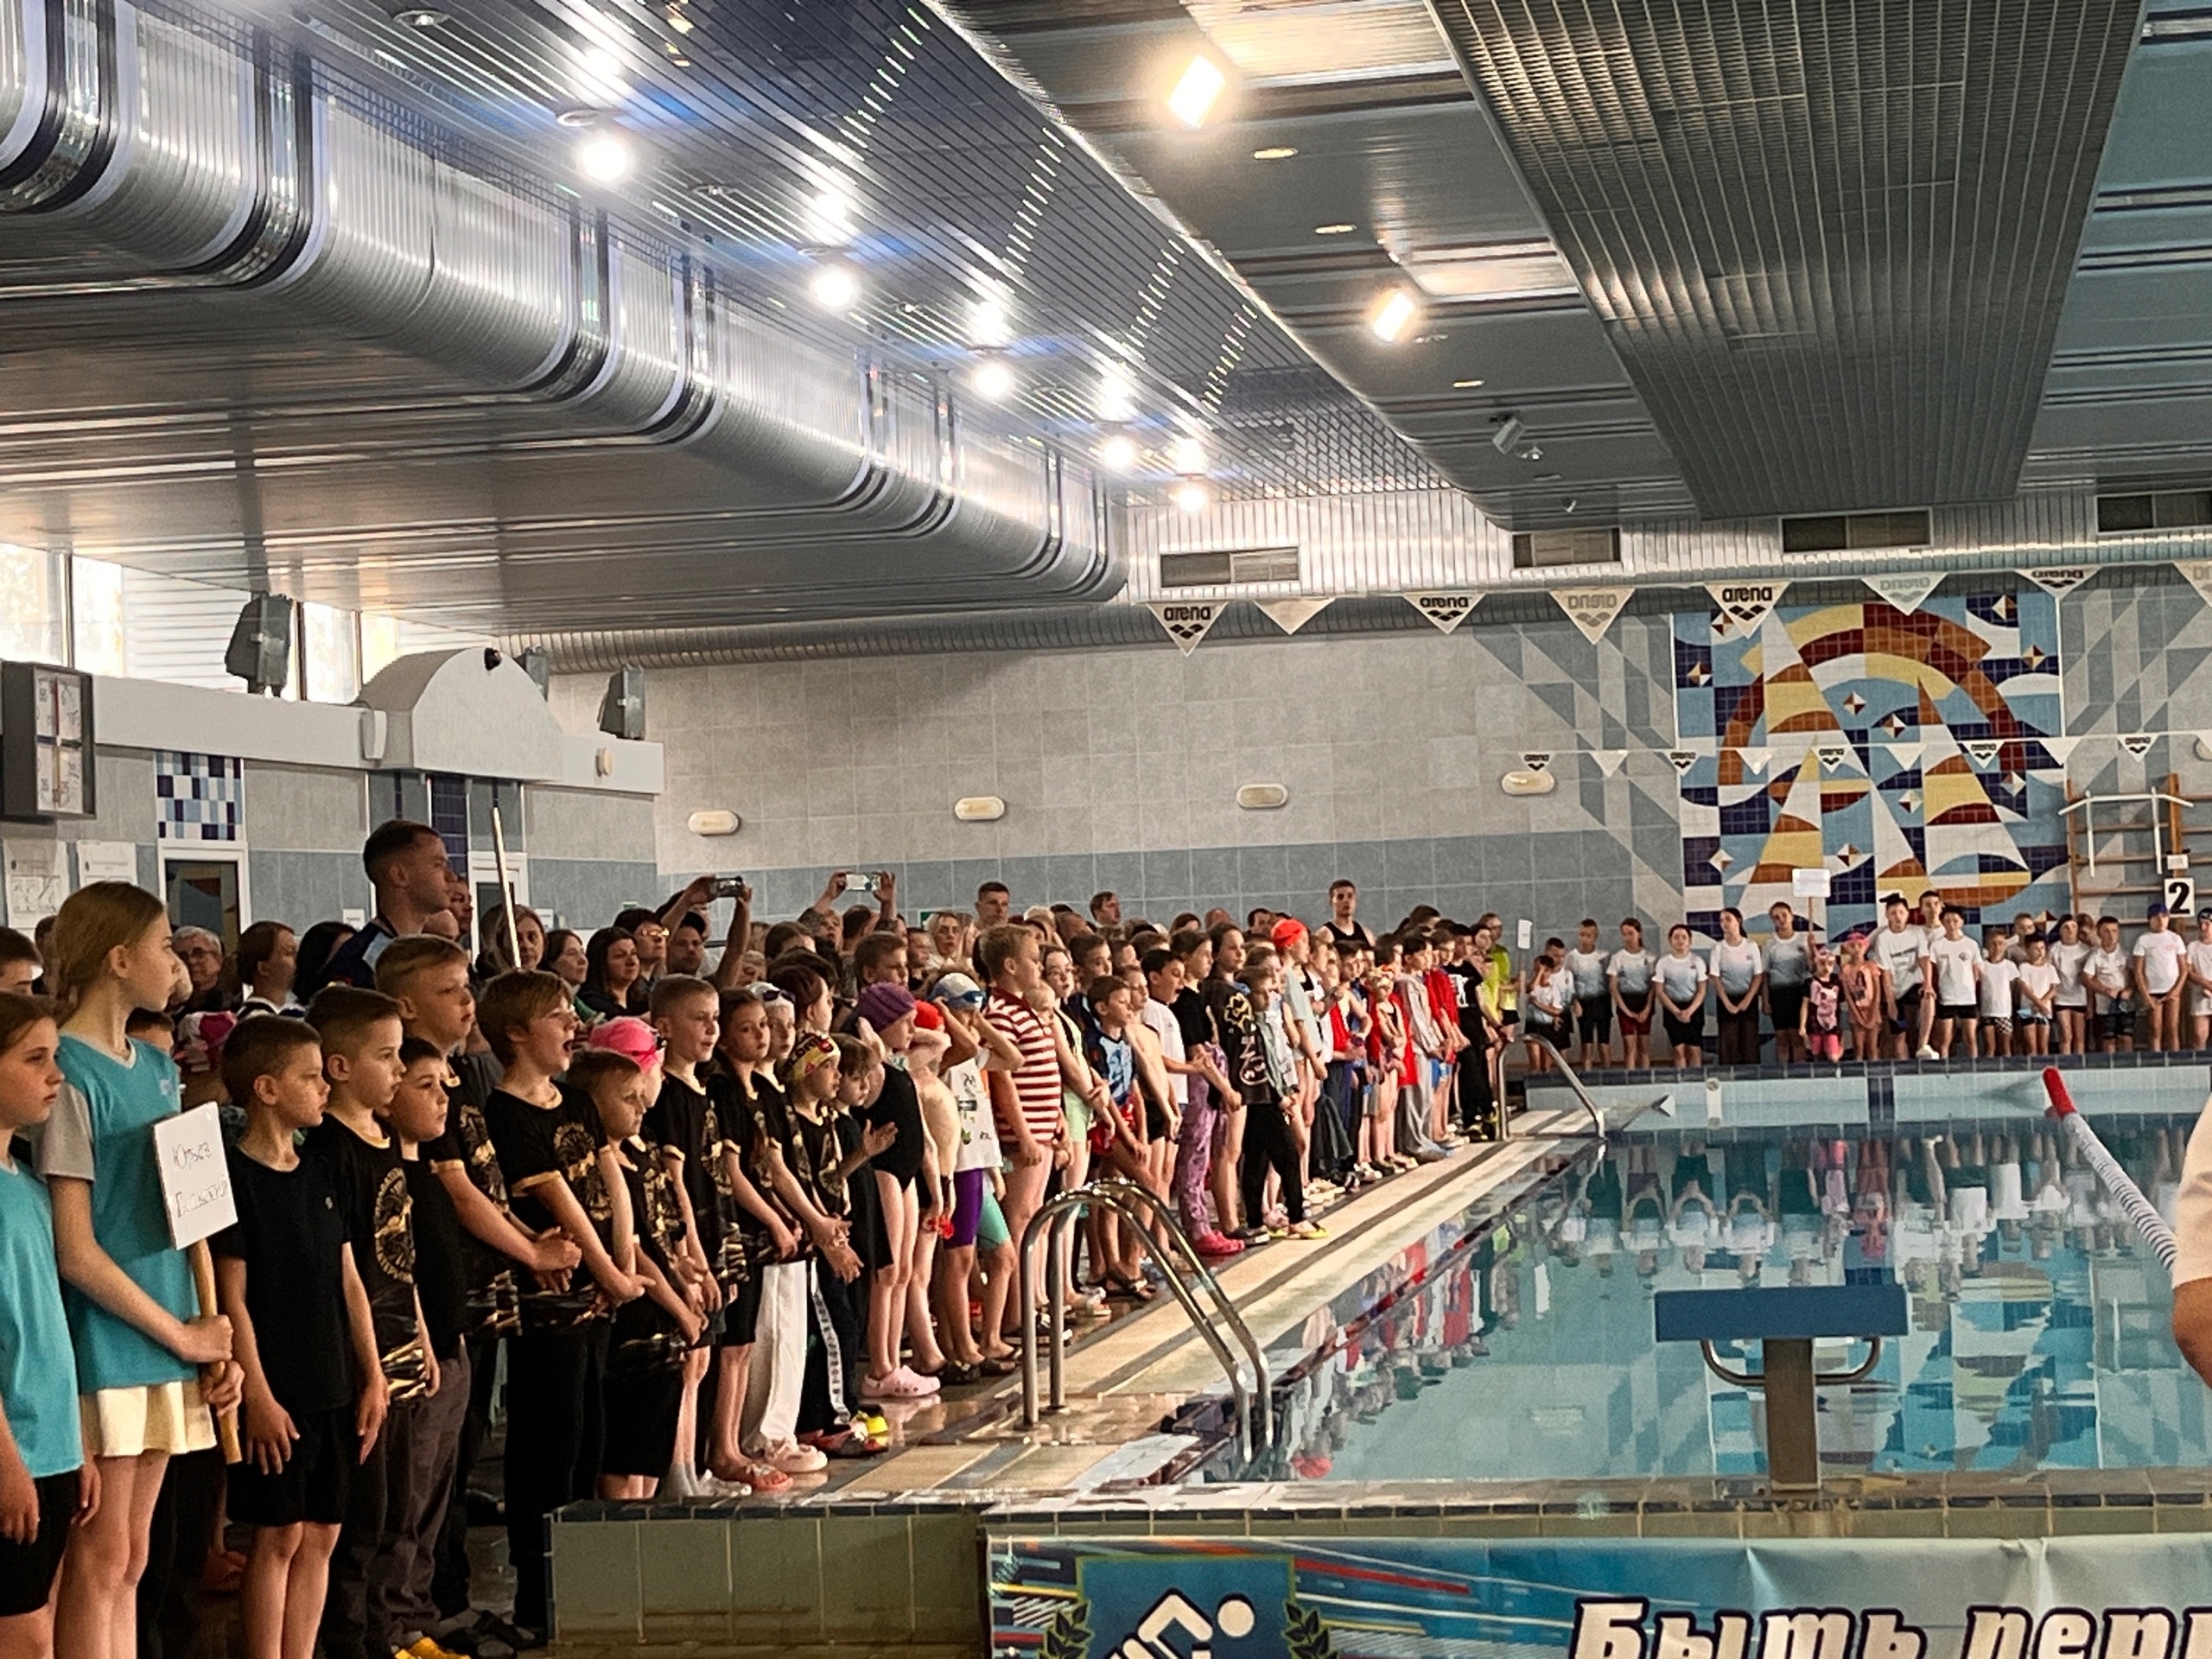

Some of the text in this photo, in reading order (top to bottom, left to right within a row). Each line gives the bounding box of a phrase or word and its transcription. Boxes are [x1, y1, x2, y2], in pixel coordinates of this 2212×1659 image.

[2031, 569, 2083, 579] arena
[1722, 586, 1773, 602] arena
[1420, 596, 1469, 609] arena
[1164, 606, 1211, 621] arena
[2169, 881, 2190, 915] 2
